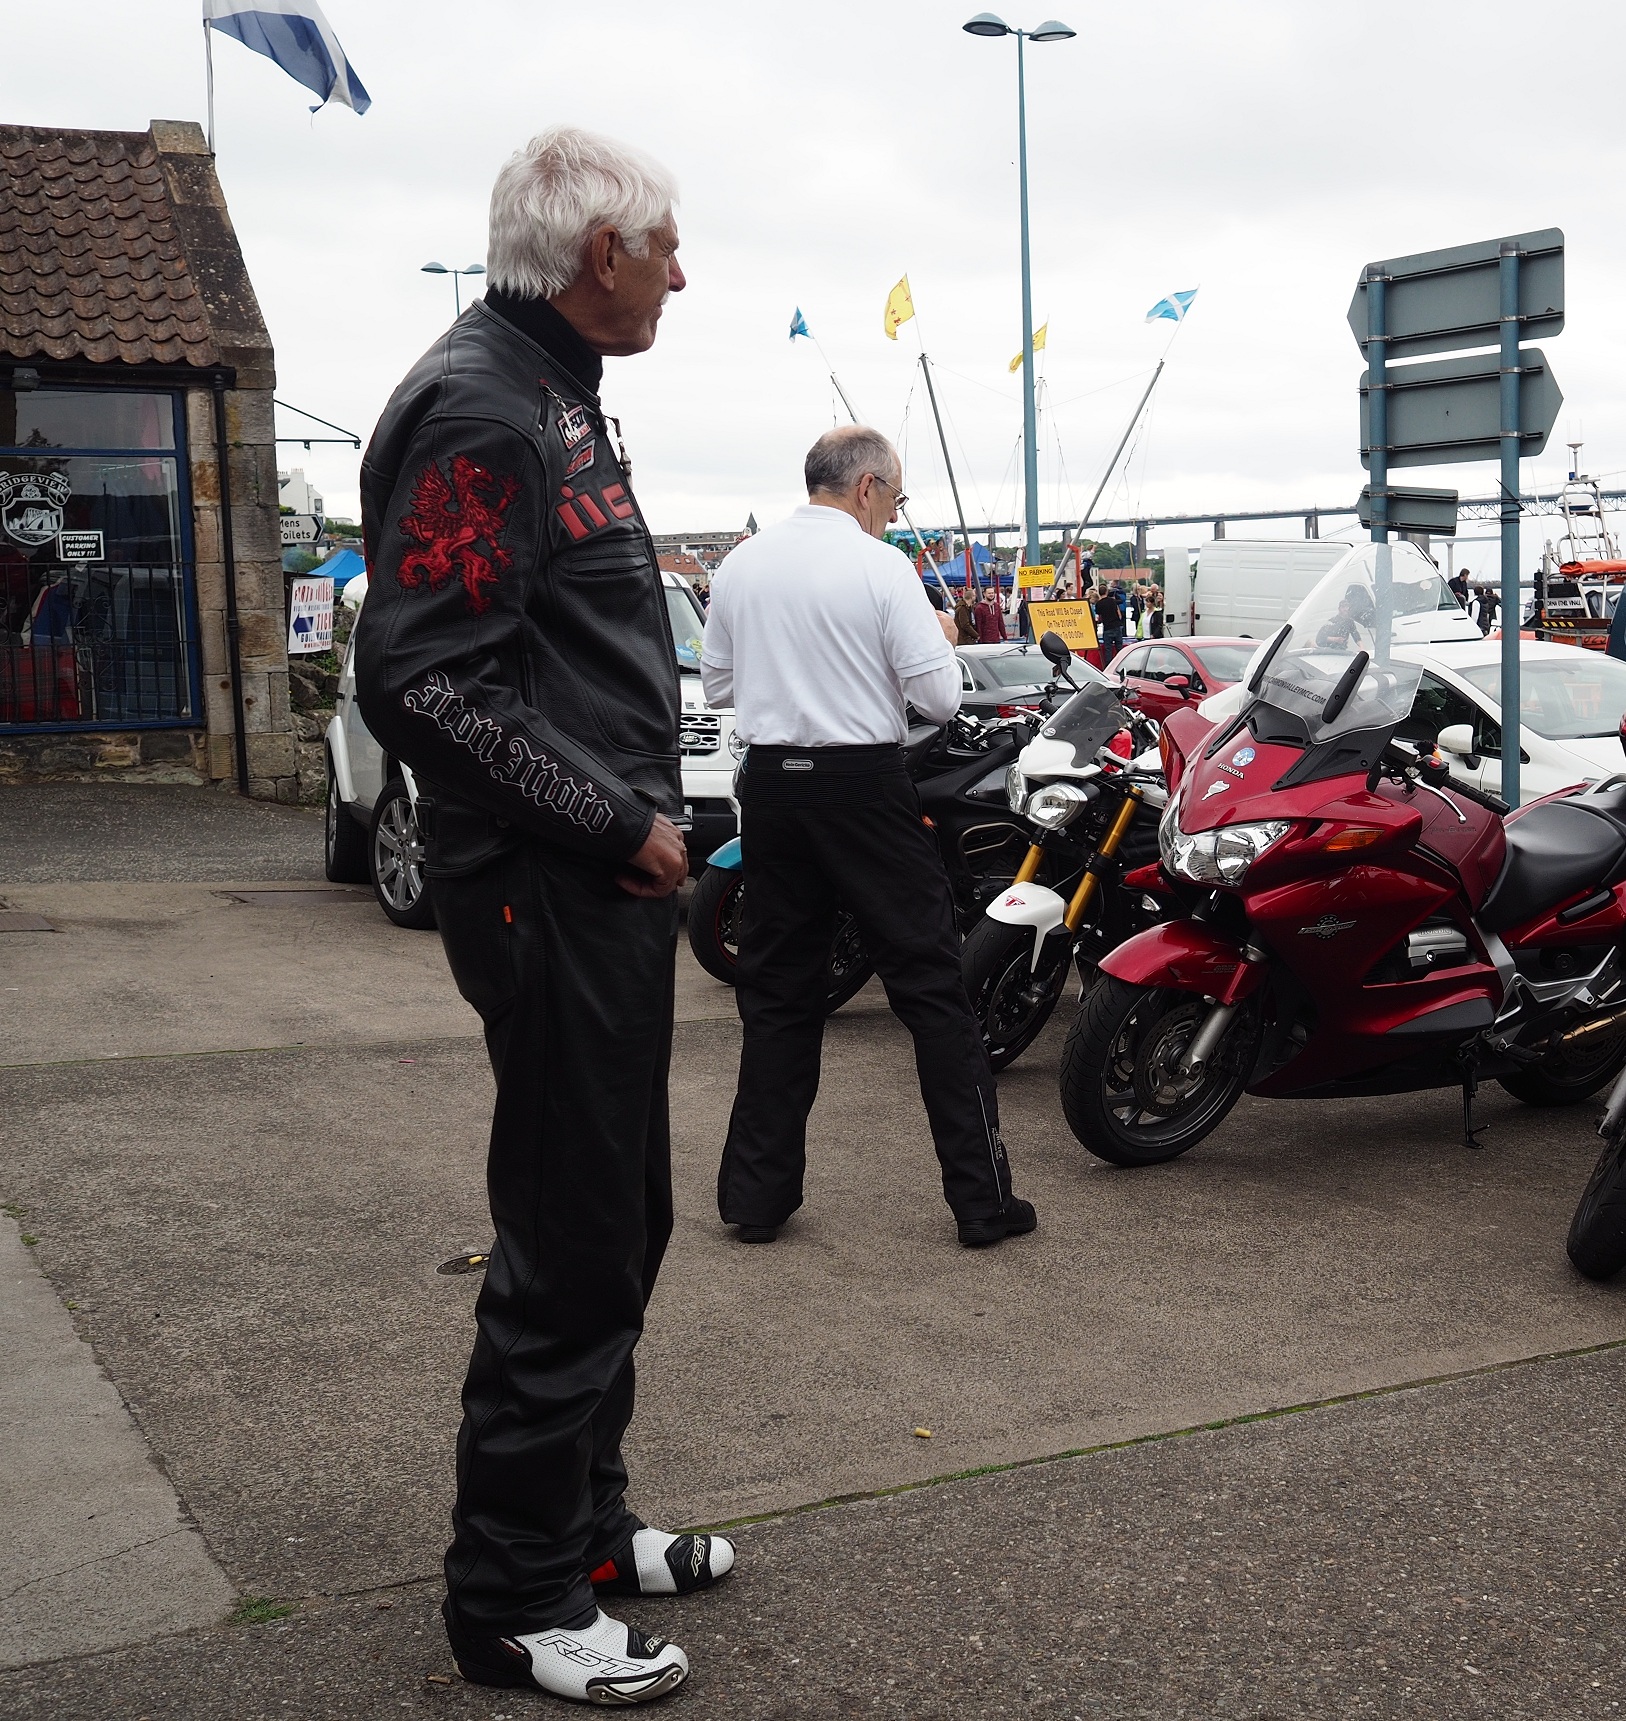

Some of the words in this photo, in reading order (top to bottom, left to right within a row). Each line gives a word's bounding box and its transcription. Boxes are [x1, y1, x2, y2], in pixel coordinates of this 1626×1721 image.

[0, 475, 67, 492] RIDGEVIEW
[1217, 762, 1245, 780] HONDA
[690, 1534, 706, 1577] RST
[645, 1635, 663, 1654] RS
[537, 1633, 645, 1676] RST
